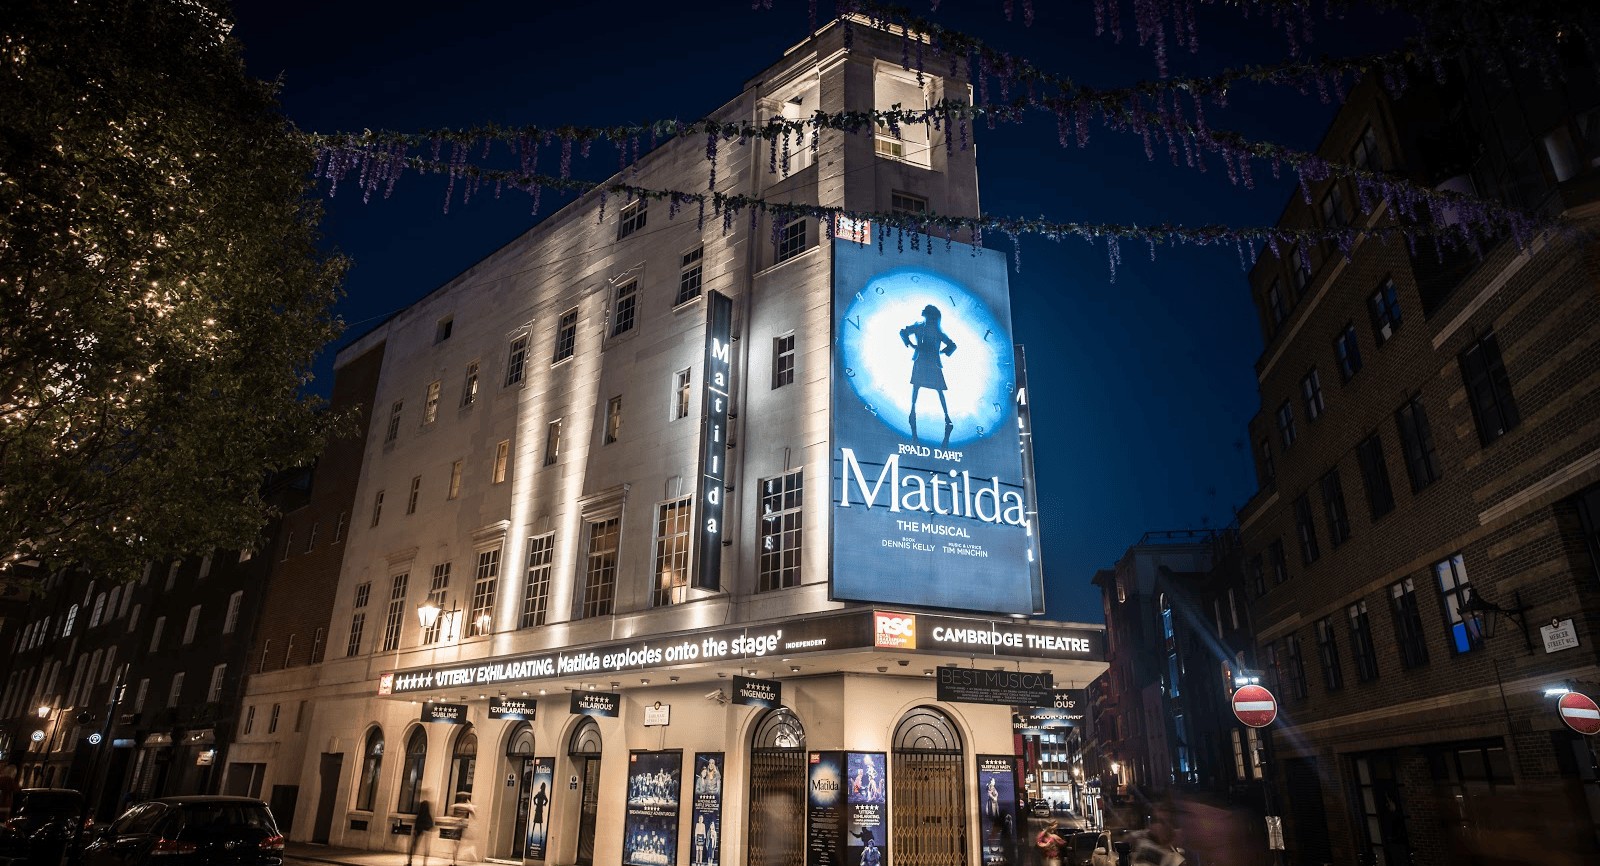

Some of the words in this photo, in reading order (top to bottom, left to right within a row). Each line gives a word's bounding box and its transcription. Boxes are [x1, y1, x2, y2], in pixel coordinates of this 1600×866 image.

[707, 337, 729, 534] Matilda
[898, 444, 931, 457] ROALD
[840, 448, 1030, 527] Matilda
[896, 520, 919, 532] THE
[922, 523, 971, 538] MUSICAL
[882, 540, 911, 550] DENNIS
[912, 543, 936, 552] KELLY
[942, 546, 956, 554] TIM
[957, 547, 988, 558] MINCHIN
[876, 616, 913, 637] RSC
[1549, 631, 1568, 640] MERCER
[932, 627, 1024, 648] CAMBRIDGE
[1026, 634, 1090, 652] THEATRE
[1547, 638, 1565, 648] STREET
[477, 658, 555, 683] EXHILARATING.
[558, 652, 600, 674] Matilda
[602, 647, 662, 671] explodes
[664, 641, 699, 662] onto
[702, 637, 728, 658] the
[785, 638, 827, 649] INDEPENDENT
[941, 668, 980, 685] BEST
[985, 672, 1053, 690] MUSICAL
[811, 779, 839, 791] Matilda
